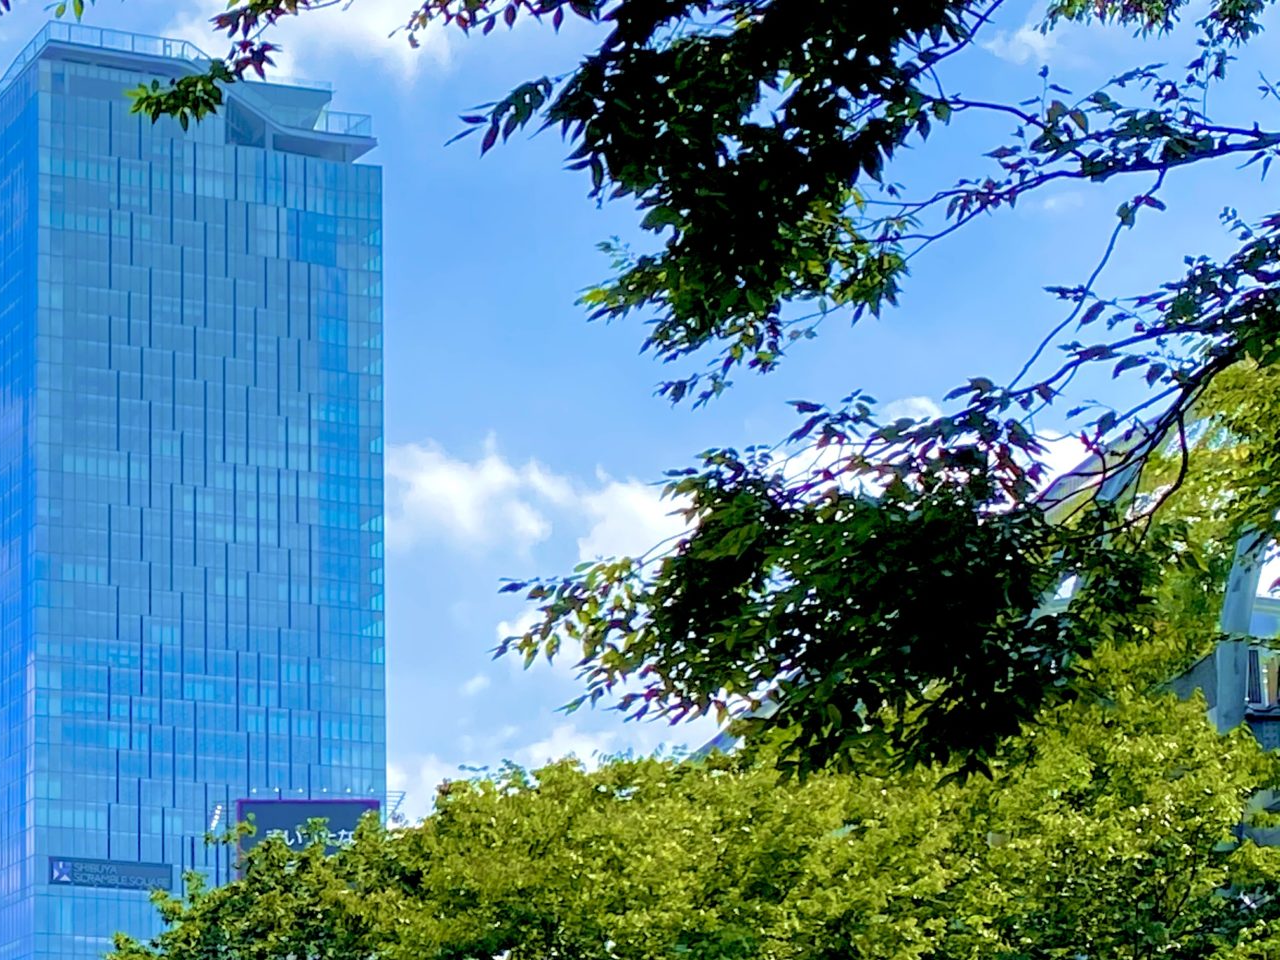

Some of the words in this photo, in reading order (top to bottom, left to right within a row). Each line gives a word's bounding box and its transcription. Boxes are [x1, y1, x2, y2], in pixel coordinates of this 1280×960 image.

[73, 862, 118, 874] SHIBUYA
[73, 872, 127, 885] SCRAMBLE
[128, 876, 169, 888] SQUARE
